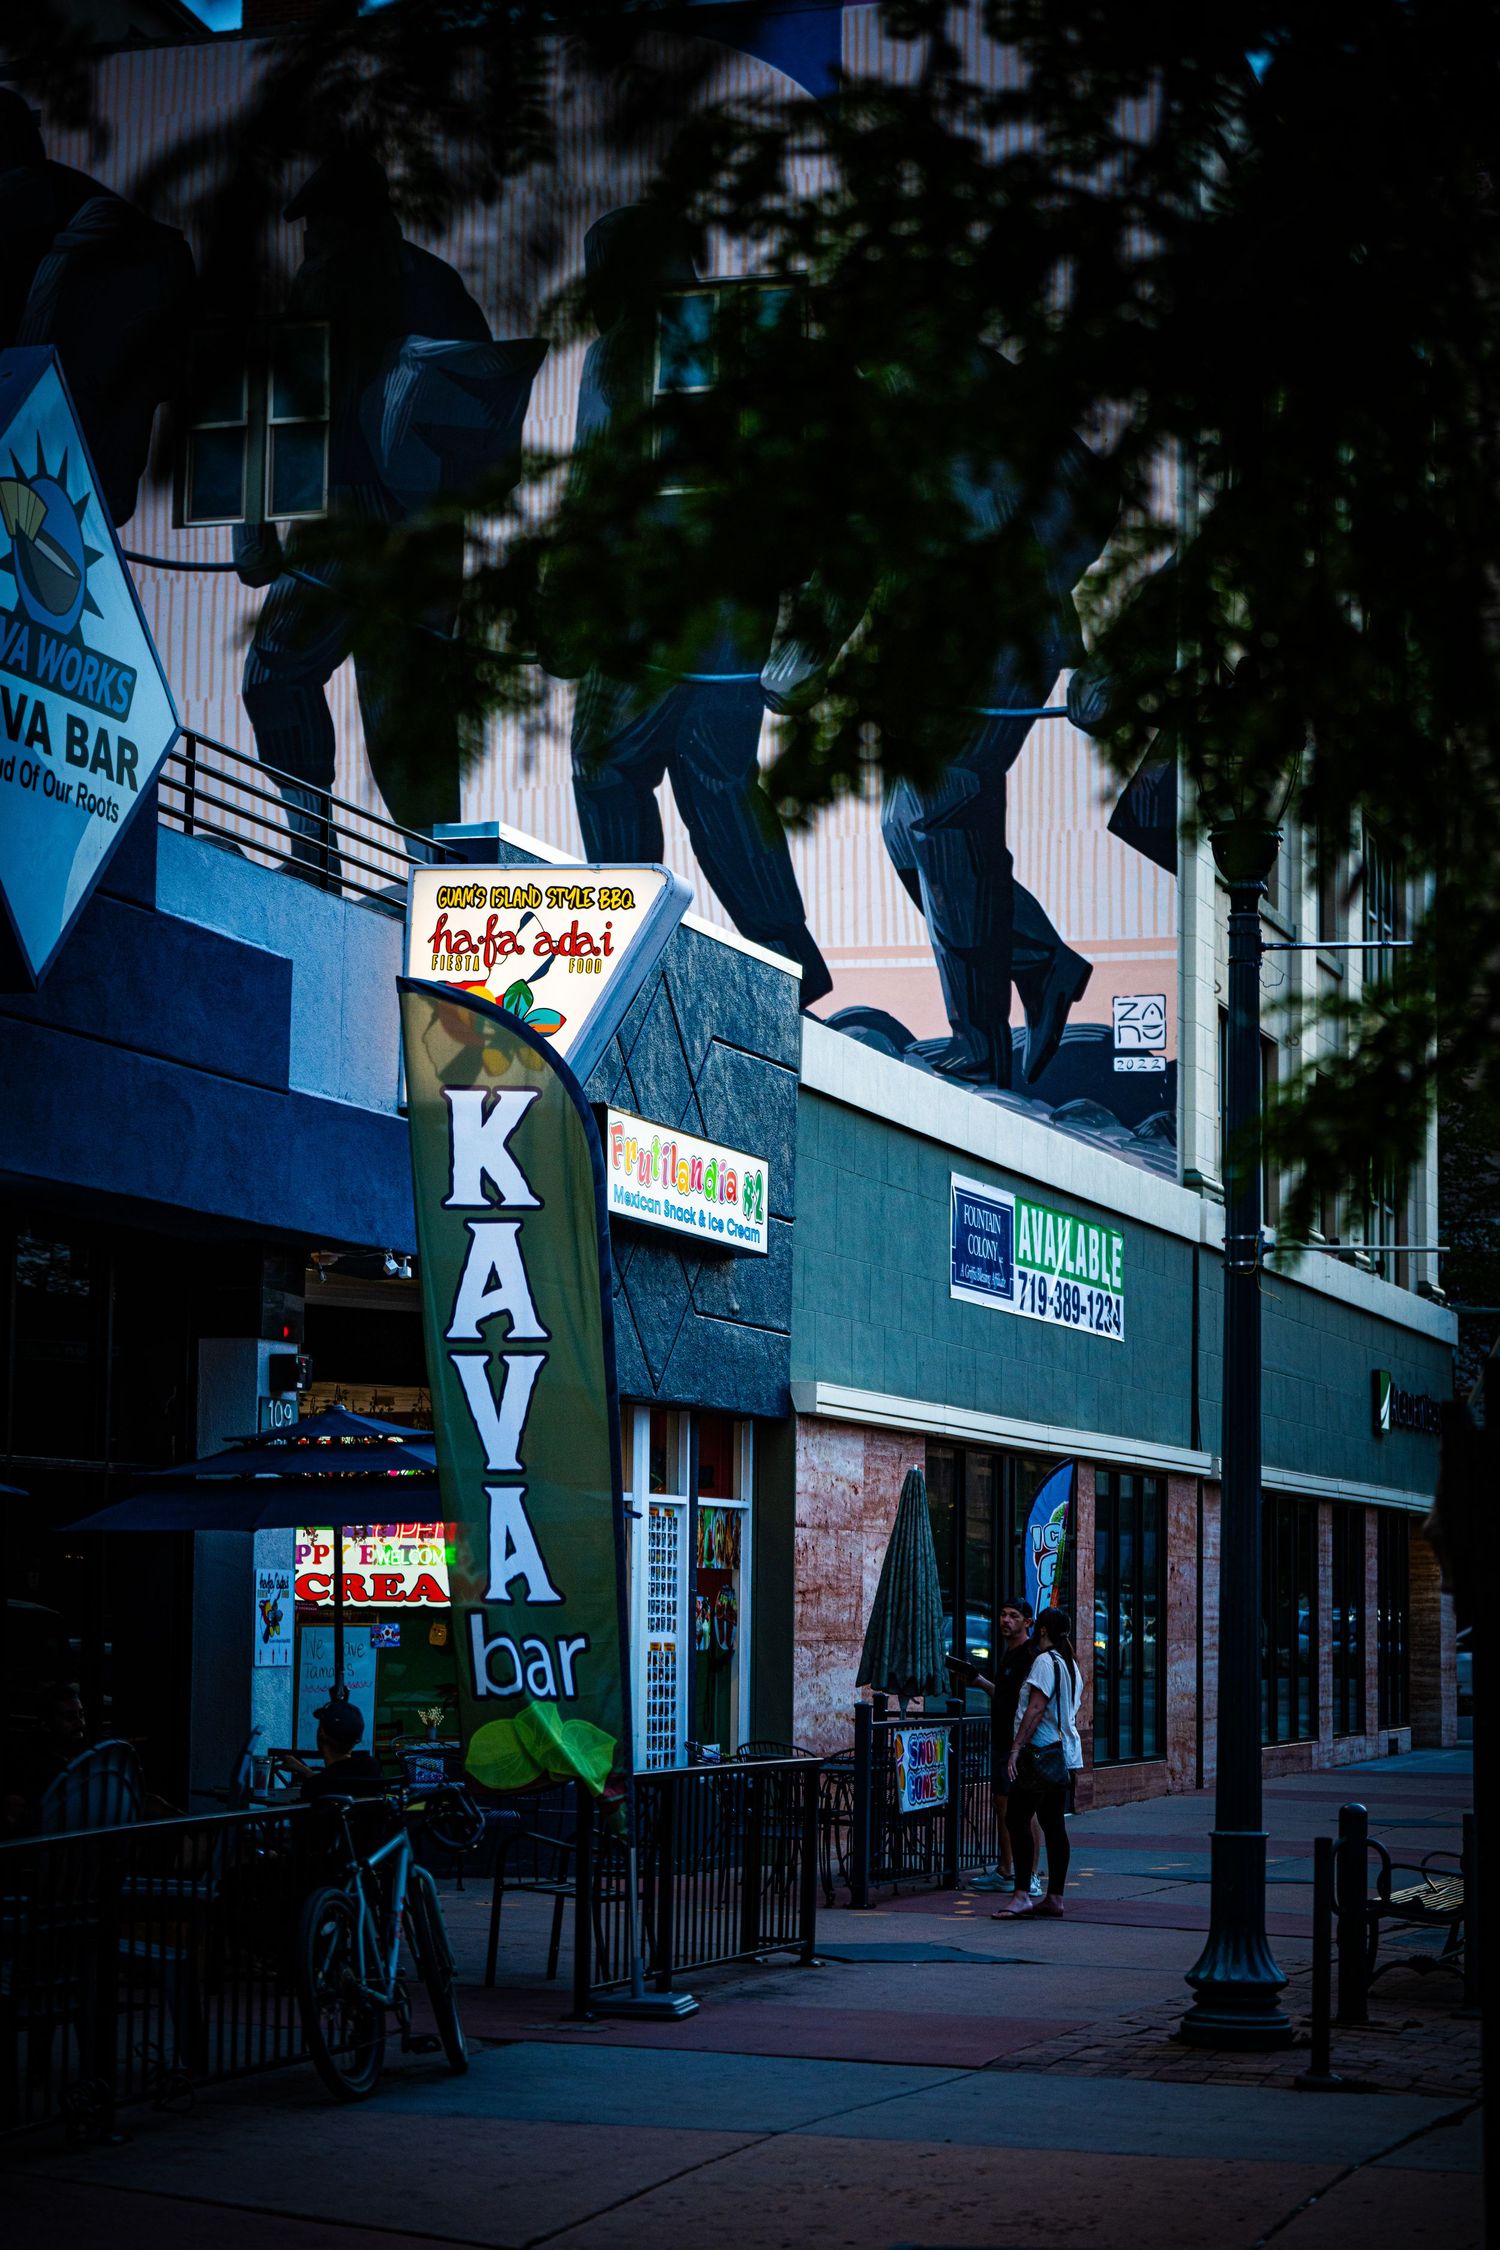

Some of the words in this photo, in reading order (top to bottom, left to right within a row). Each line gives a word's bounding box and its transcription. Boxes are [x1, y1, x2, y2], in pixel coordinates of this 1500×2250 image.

[35, 632, 134, 716] WORKS
[65, 713, 139, 793] BAR
[20, 760, 40, 792] Of
[43, 770, 73, 804] Our
[75, 781, 120, 824] Roots
[437, 884, 487, 909] GUAM'S
[490, 884, 542, 909] ISLAND
[545, 886, 595, 910] STYLE
[598, 888, 635, 910] BBQ
[431, 955, 480, 971] FIESTA
[568, 958, 602, 974] FOOD
[1117, 1059, 1161, 1070] 2022
[610, 1121, 738, 1205] Frutilandia
[613, 1183, 661, 1215] Mexican
[663, 1199, 697, 1226] Snack
[698, 1209, 706, 1228] &
[708, 1212, 725, 1234] Ice
[726, 1217, 761, 1244] Cream
[963, 1203, 1001, 1234] FOUNTAIN
[967, 1233, 998, 1262] COLONY
[1018, 1205, 1122, 1289] AVAILABLE
[1018, 1270, 1121, 1335] 719-389-1234
[440, 1085, 566, 1604] KAVA
[267, 1400, 292, 1427] 109
[343, 1641, 366, 1658] ave
[468, 1612, 588, 1698] bar
